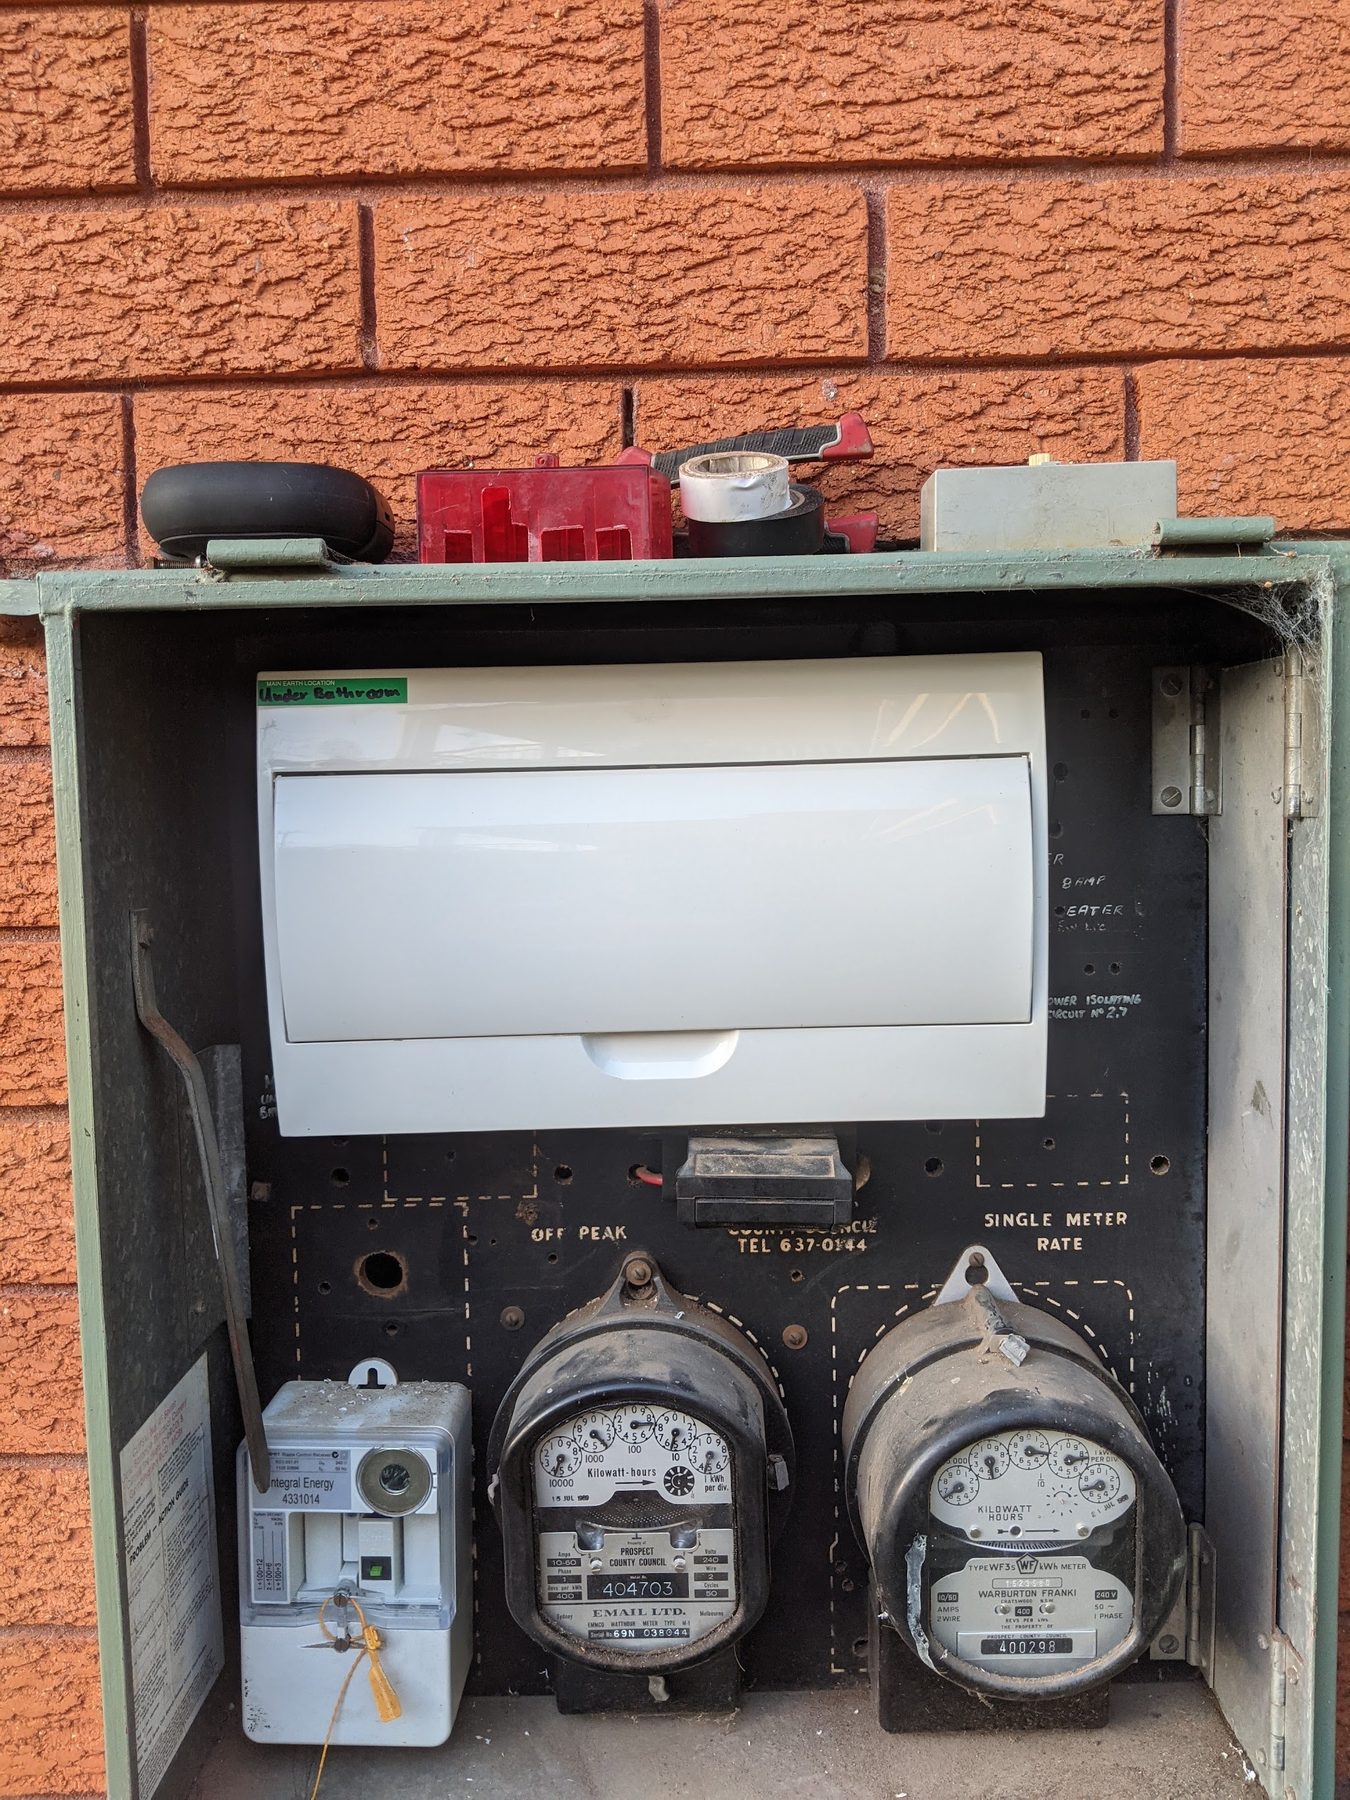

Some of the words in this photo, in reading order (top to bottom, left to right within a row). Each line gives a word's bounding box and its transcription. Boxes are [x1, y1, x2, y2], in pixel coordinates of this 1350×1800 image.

[259, 688, 308, 702] Under
[313, 686, 401, 700] Bathroom
[984, 1212, 1052, 1228] SINGLE
[1066, 1211, 1128, 1227] METER
[531, 1227, 565, 1241] OFF
[579, 1225, 628, 1241] PEAK
[738, 1238, 771, 1253] TEL
[1037, 1237, 1083, 1251] RATE
[628, 1446, 642, 1454] 100
[585, 1454, 604, 1463] 1000
[672, 1453, 680, 1461] 10
[303, 1477, 334, 1491] Energy
[549, 1479, 574, 1487] 10000
[710, 1475, 724, 1483] kWh
[282, 1493, 320, 1504] 4331014
[129, 1529, 152, 1566] PROBLEM
[158, 1498, 175, 1525] ACTION
[620, 1547, 654, 1556] PROSPECT
[609, 1558, 636, 1567] COUNTY
[638, 1558, 667, 1566] COUNCIL
[603, 1582, 673, 1596] 404703
[978, 1590, 1036, 1598] WARBURTON
[1042, 1589, 1077, 1597] FRANKI
[592, 1608, 648, 1618] EMAIL
[652, 1607, 686, 1617] LTD.
[614, 1629, 635, 1638] 69N
[999, 1640, 1056, 1654] 400298
